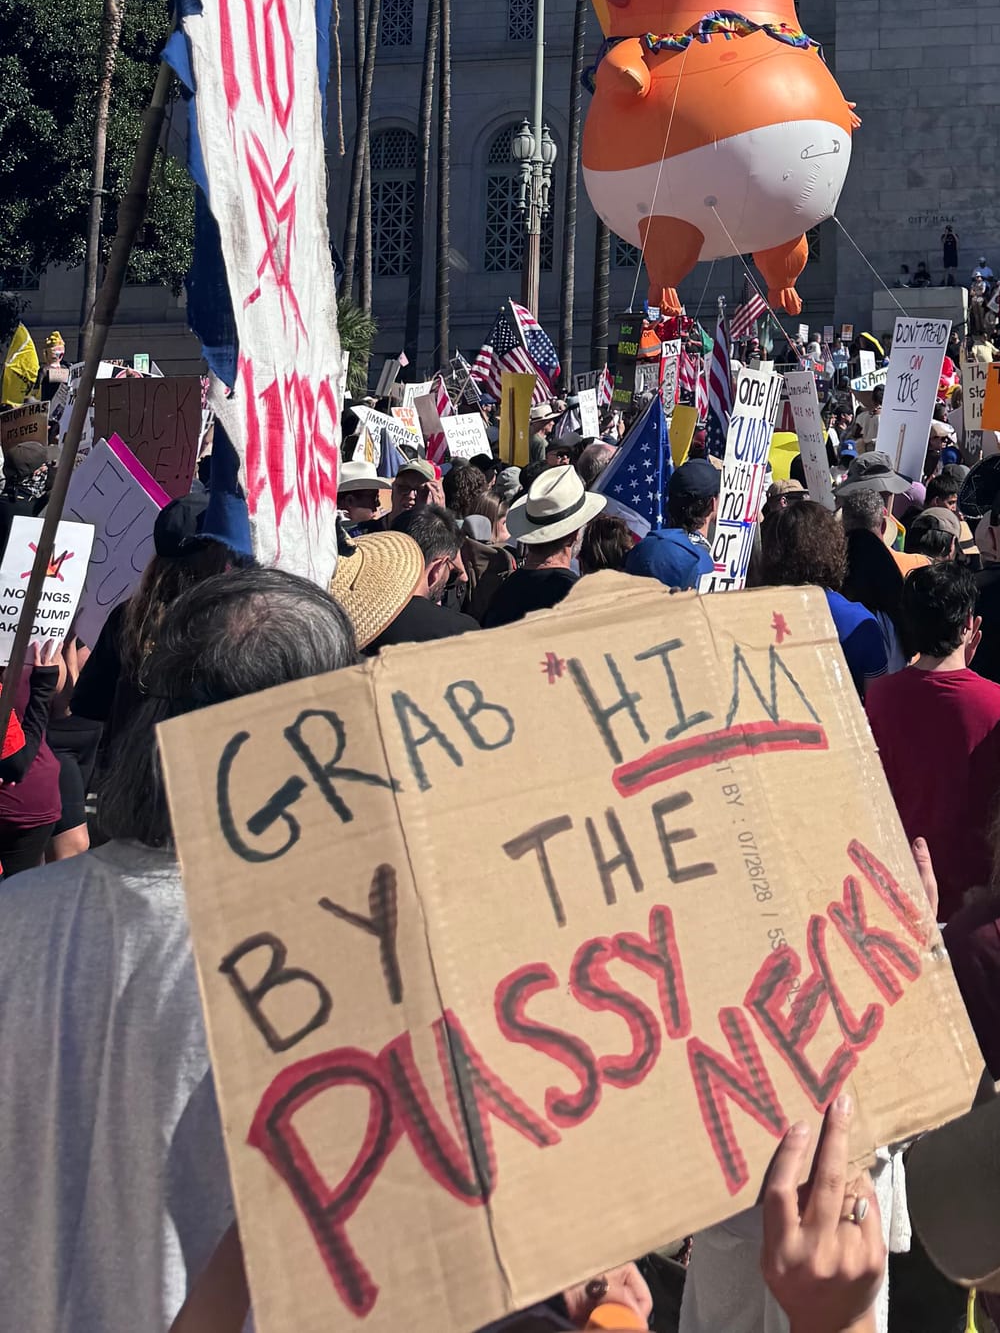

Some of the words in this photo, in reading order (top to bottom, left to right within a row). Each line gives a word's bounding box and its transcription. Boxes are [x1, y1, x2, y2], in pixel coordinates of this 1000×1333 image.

[909, 354, 924, 370] ON
[739, 377, 765, 407] one
[855, 375, 868, 390] US
[28, 403, 48, 416] HAS
[105, 382, 193, 446] FUCK
[20, 422, 38, 436] EYES
[367, 410, 420, 444] IMMIGRANTS
[722, 465, 751, 493] with
[721, 492, 744, 521] no
[713, 533, 736, 563] or
[3, 587, 26, 599] NO
[0, 605, 18, 615] NO
[35, 608, 70, 621] RUMP
[217, 678, 517, 863] GRAB
[721, 782, 745, 808] BY
[737, 830, 774, 903] 07/26/28
[219, 863, 404, 1053] BY
[502, 790, 717, 928] THE
[246, 904, 692, 1318] PUSSY
